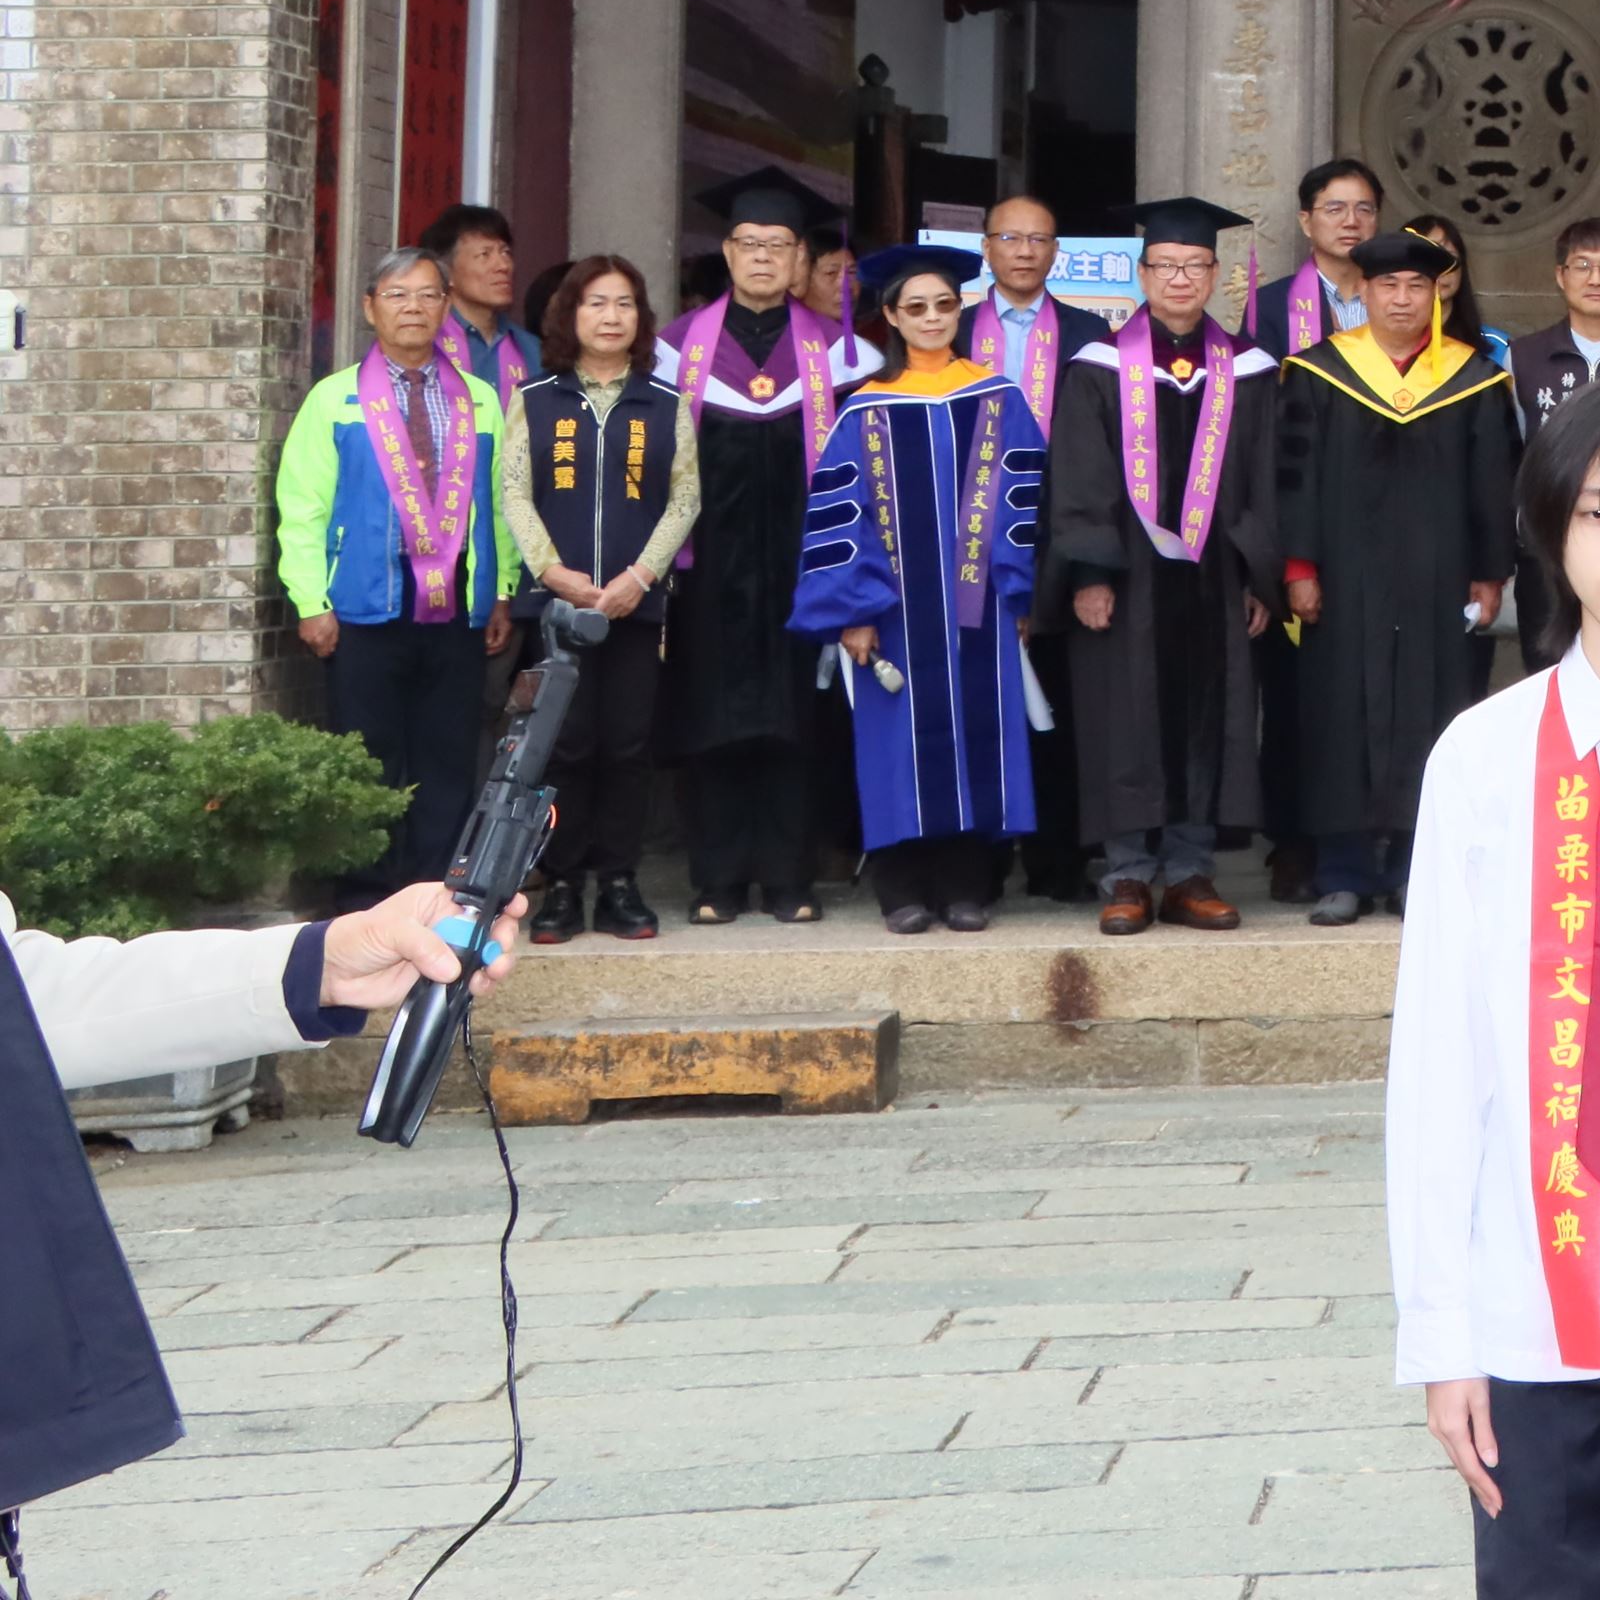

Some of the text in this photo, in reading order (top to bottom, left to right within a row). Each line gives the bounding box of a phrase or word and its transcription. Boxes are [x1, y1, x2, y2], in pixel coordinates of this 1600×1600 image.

[439, 396, 470, 537] 苗栗市文昌祠
[553, 418, 578, 490] 曾美露
[801, 339, 829, 461] ML苗栗文昌
[1128, 364, 1151, 503] 苗栗市文昌祠
[1192, 343, 1229, 497] ML苗栗文昌書院
[866, 406, 900, 575] L苗栗文昌書
[959, 399, 1000, 584] ML苗栗文昌書院
[425, 568, 447, 608] 顧問
[1544, 774, 1594, 1259] 苗栗市文昌祠慶典
